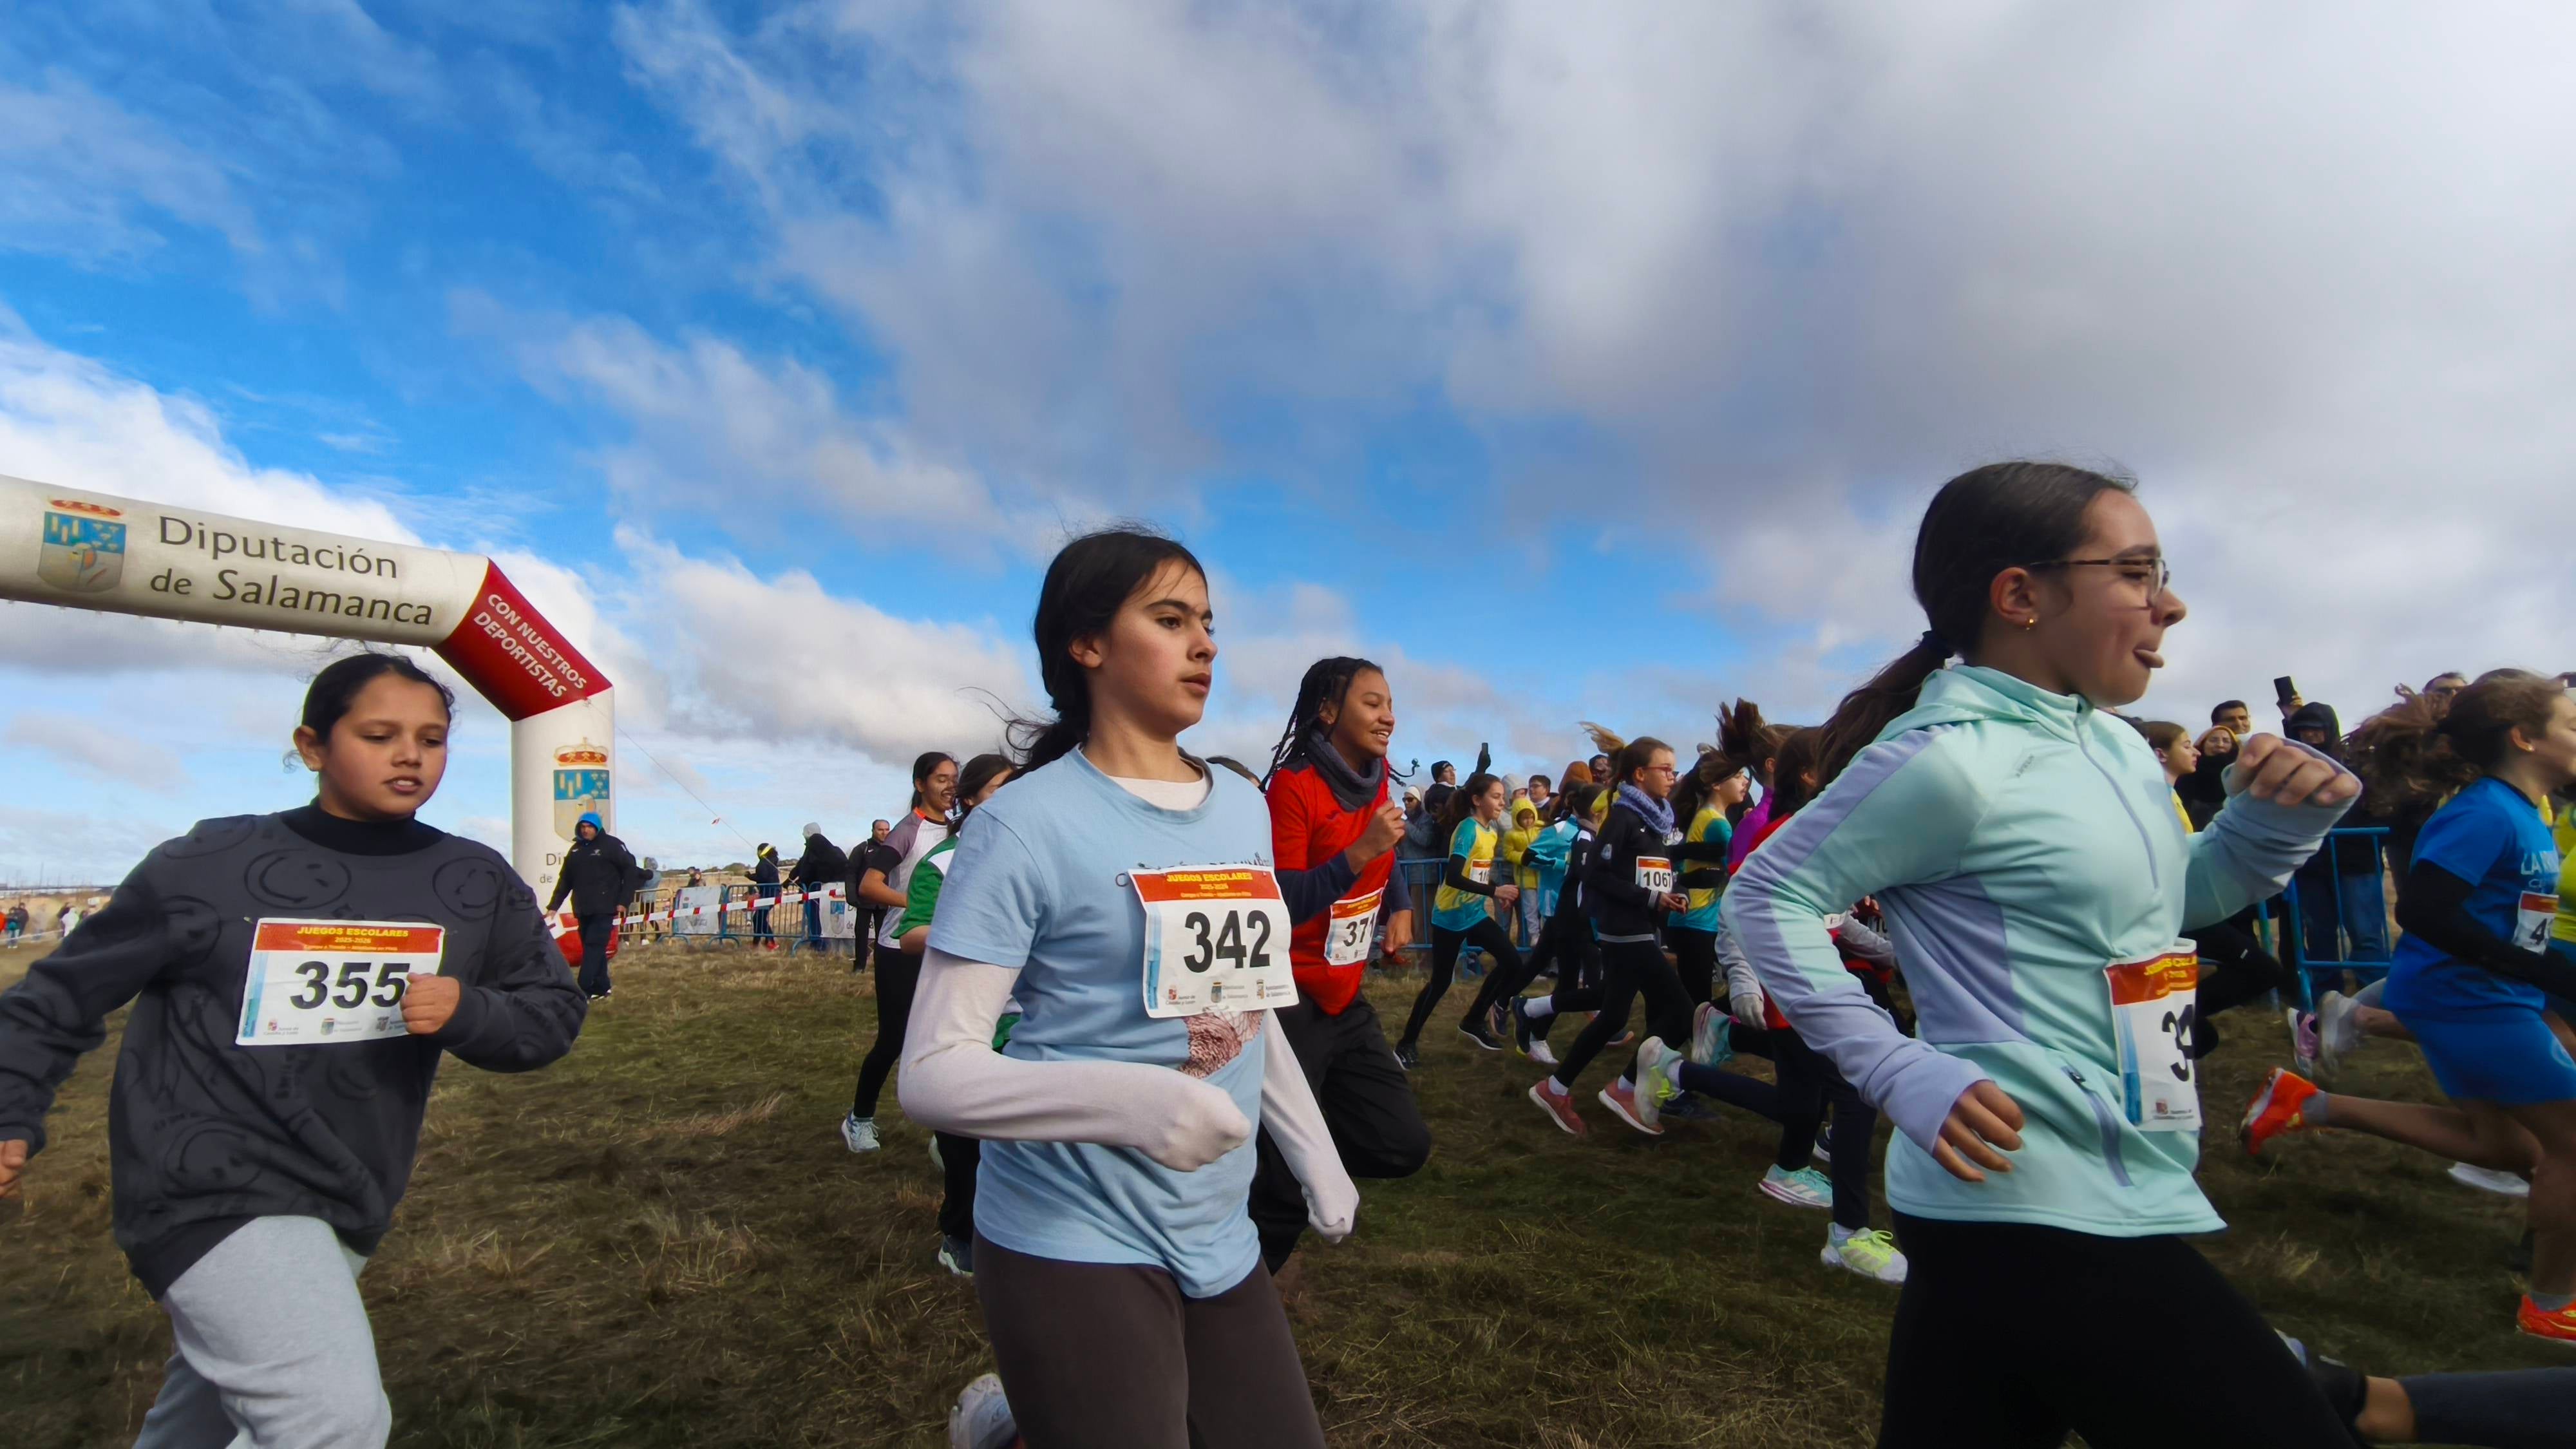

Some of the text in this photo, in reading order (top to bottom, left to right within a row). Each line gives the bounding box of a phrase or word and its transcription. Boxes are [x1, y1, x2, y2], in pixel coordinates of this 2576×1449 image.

[160, 516, 397, 578] Diputación
[151, 569, 432, 625] de Salamanca
[476, 612, 567, 697] DEPORTISTAS
[488, 594, 587, 688] CON NUESTROS
[297, 927, 408, 937] JUEGOS ESCOLARES
[1184, 910, 1271, 973] 342
[290, 961, 410, 1009] 355
